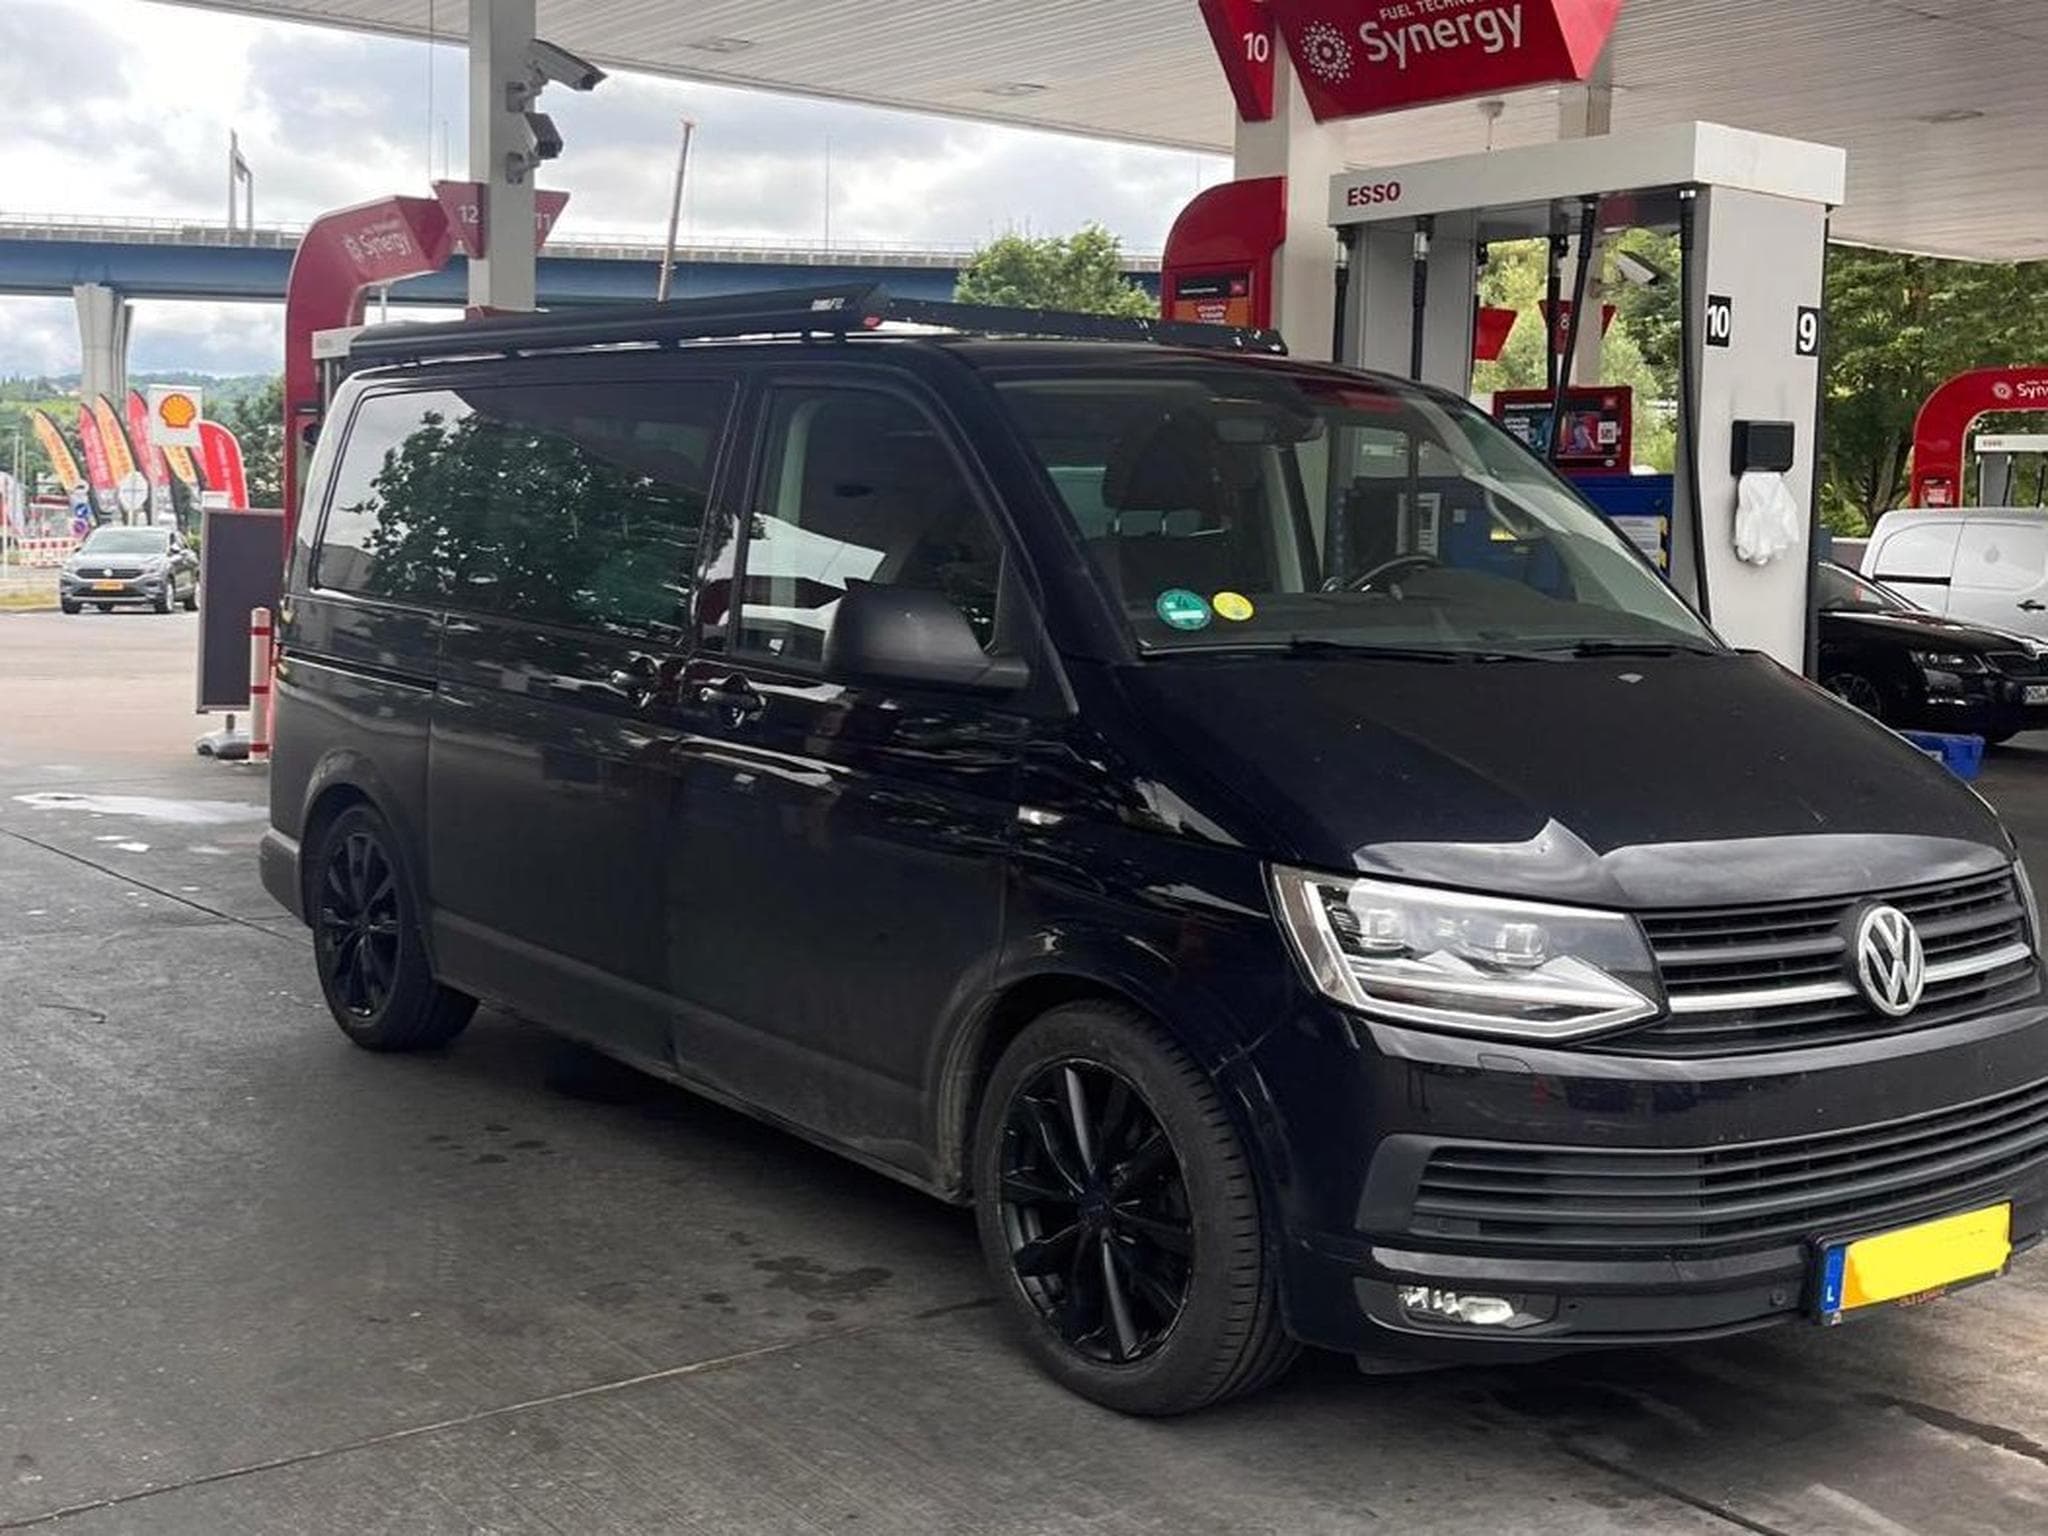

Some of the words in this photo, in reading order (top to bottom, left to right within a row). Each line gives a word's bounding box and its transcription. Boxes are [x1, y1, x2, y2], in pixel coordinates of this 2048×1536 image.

[1379, 3, 1415, 21] FUEL
[1243, 32, 1269, 63] 10
[1358, 3, 1522, 70] Synergy
[1347, 181, 1401, 206] ESSO
[459, 205, 479, 224] 12
[1708, 304, 1730, 338] 10
[1799, 312, 1817, 352] 9
[2015, 383, 2048, 399] Syn
[1826, 1284, 1835, 1302] L
